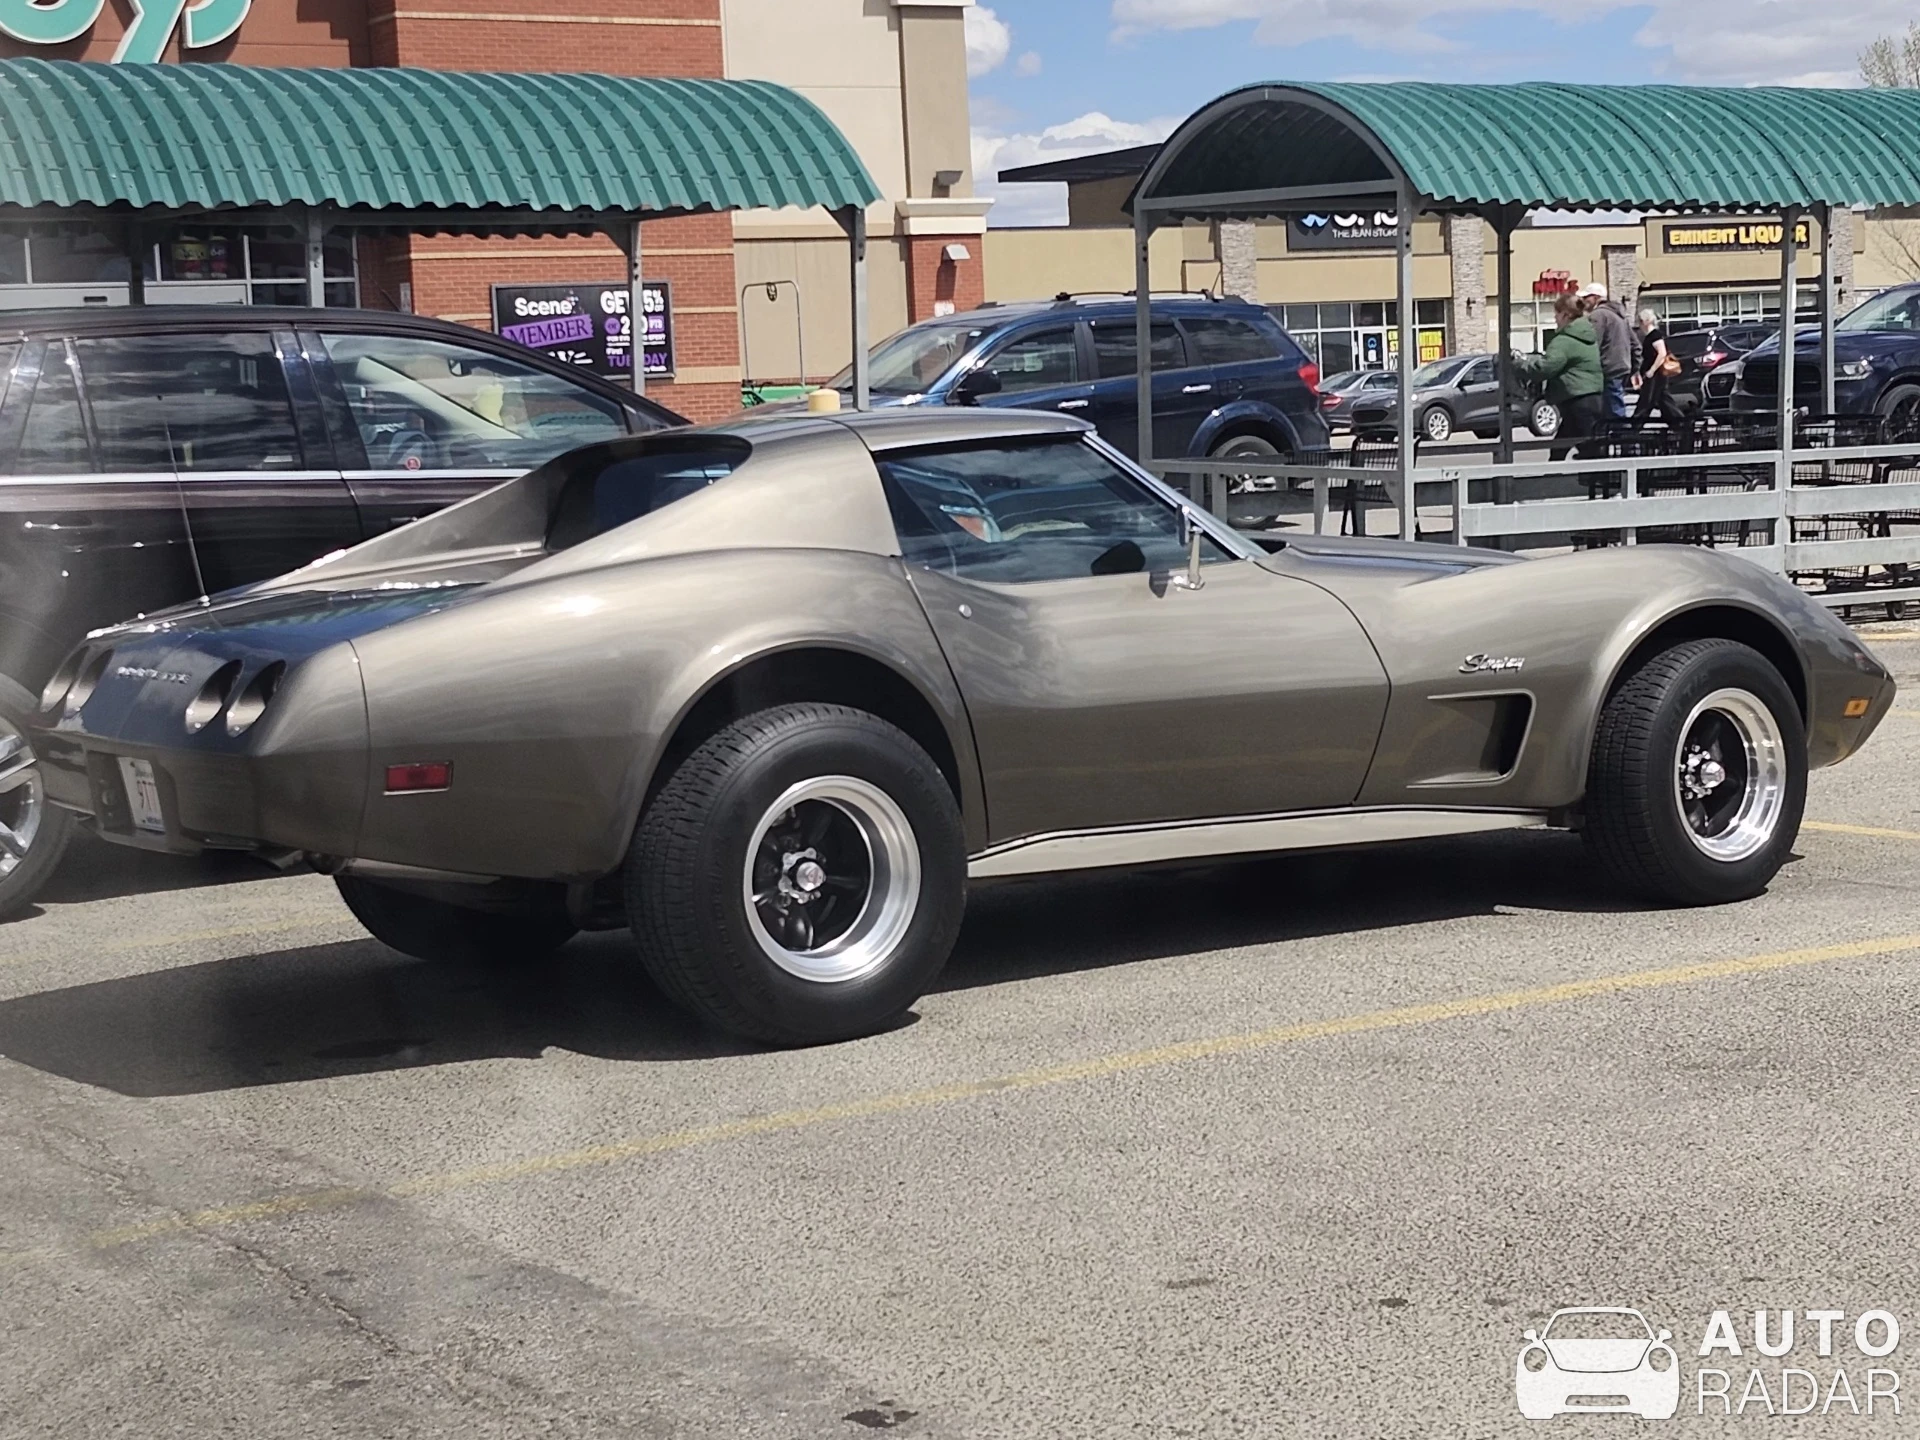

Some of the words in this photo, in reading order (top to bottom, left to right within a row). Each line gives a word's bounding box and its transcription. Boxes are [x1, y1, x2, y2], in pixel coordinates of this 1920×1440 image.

[1332, 229, 1350, 238] THE
[1351, 228, 1372, 238] JEAN
[1669, 229, 1737, 245] EMINENT
[1738, 225, 1807, 244] LIQUR
[508, 318, 589, 345] MEMBER
